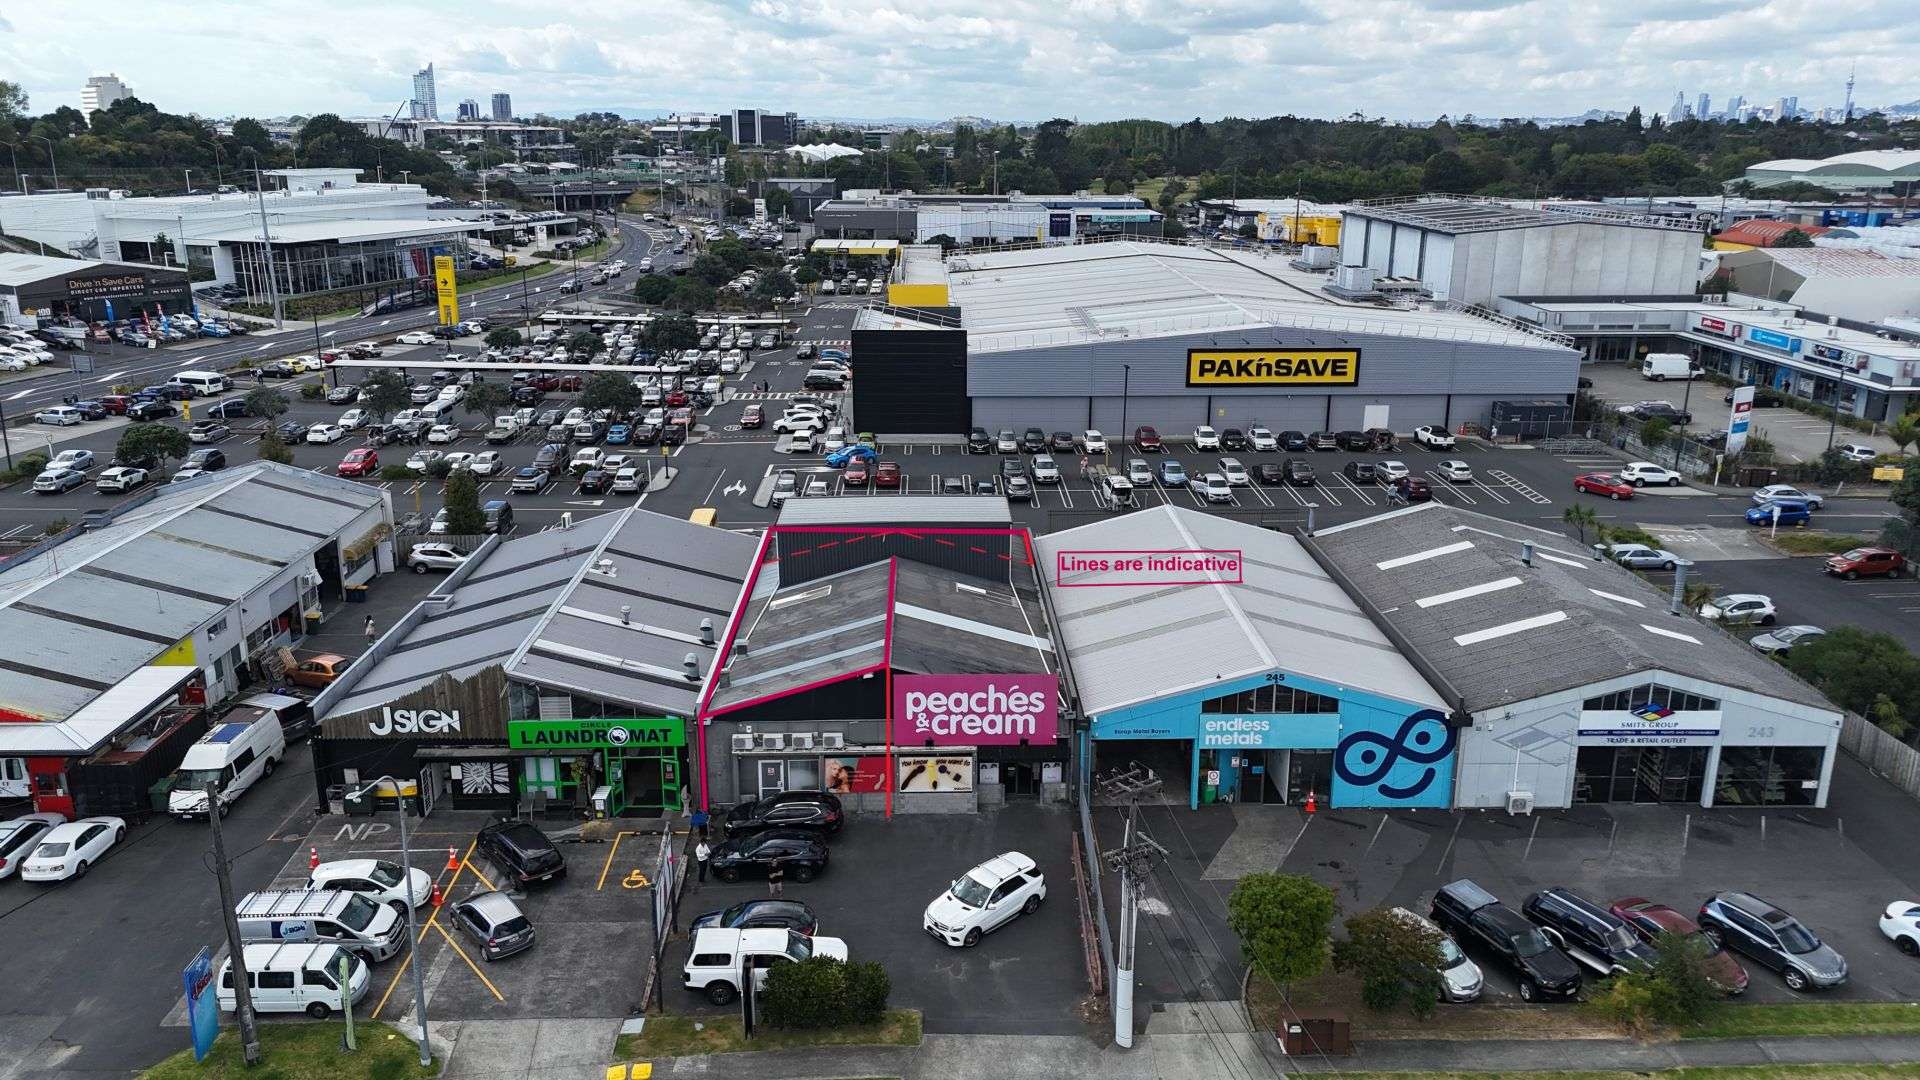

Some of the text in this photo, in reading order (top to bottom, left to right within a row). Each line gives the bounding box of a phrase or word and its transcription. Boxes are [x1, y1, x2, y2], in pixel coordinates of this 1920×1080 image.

[69, 280, 92, 289] Drive
[101, 277, 122, 286] Save
[123, 276, 144, 284] Cars
[1265, 673, 1286, 683] 245
[931, 713, 1036, 735] cream
[1205, 716, 1270, 731] endless
[1205, 731, 1263, 746] metals
[1748, 726, 1775, 738] 243
[334, 822, 392, 840] NP
